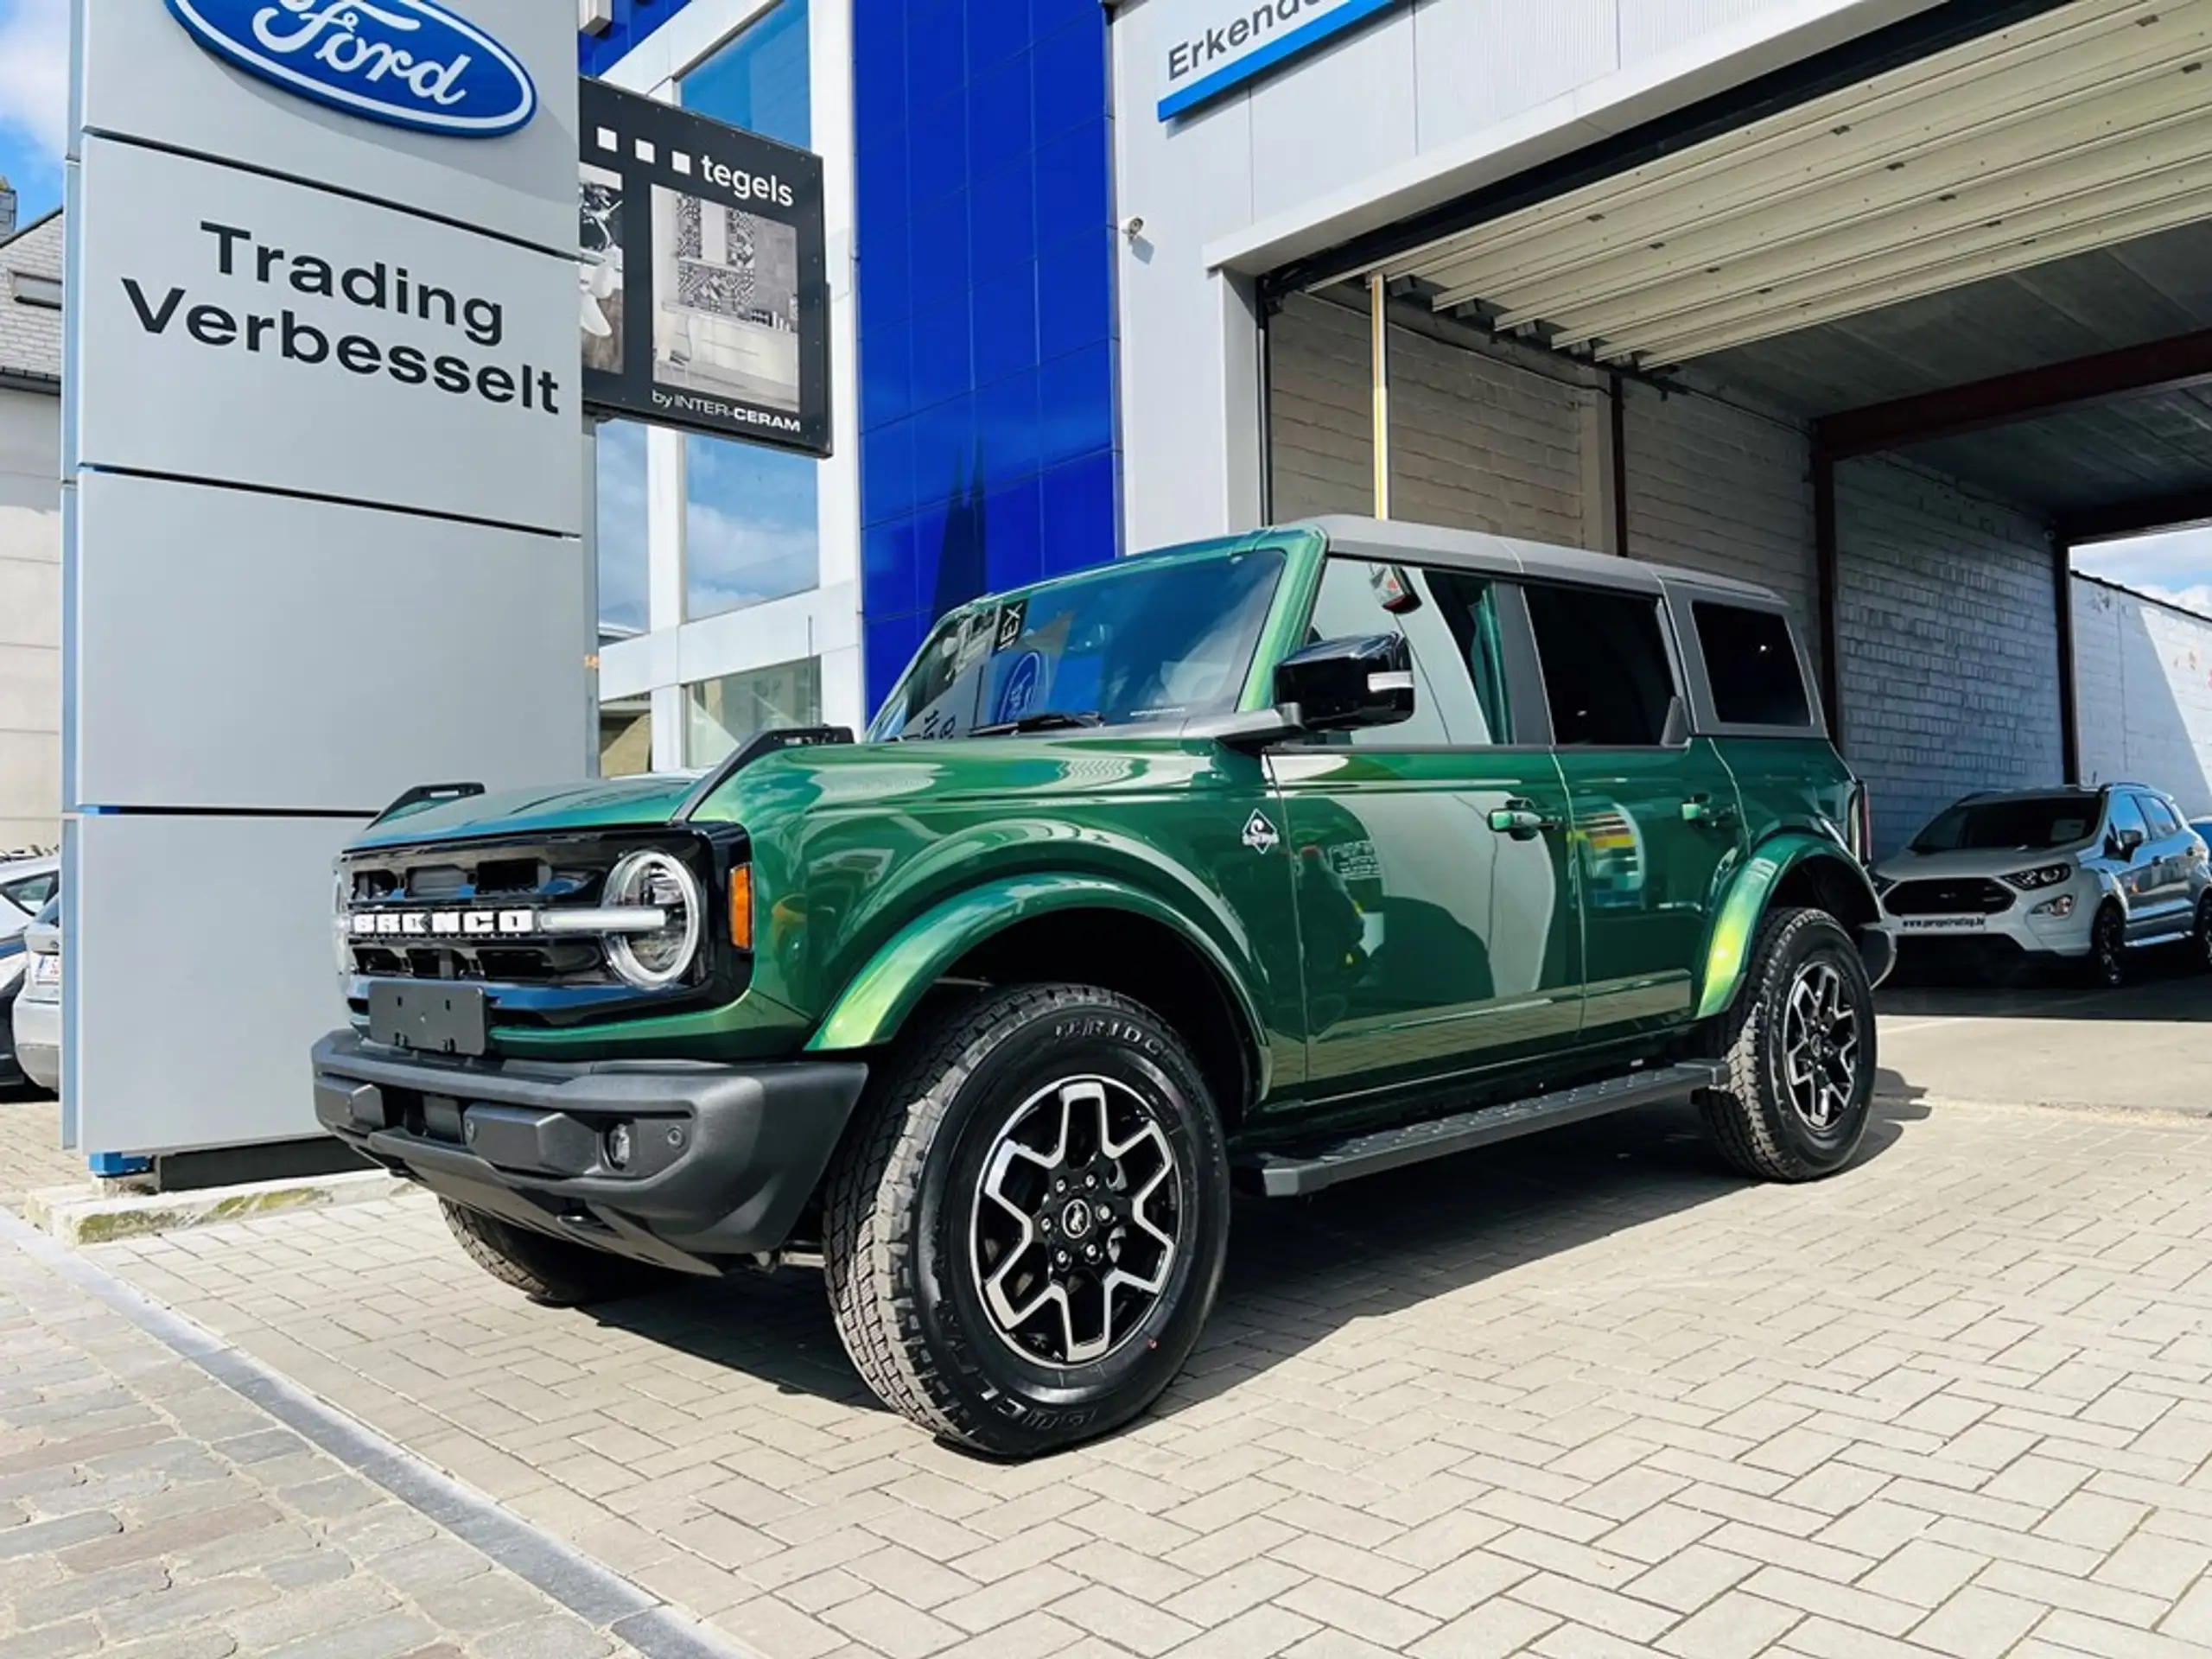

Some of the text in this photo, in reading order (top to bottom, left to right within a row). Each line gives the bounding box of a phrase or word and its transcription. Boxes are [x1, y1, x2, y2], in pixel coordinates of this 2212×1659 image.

[252, 0, 472, 105] Ford
[1168, 0, 1321, 81] Erkend
[700, 155, 794, 207] tegels
[200, 220, 504, 347] Trading
[120, 276, 560, 416] Verbesselt
[652, 390, 802, 433] by INTER-CERAM
